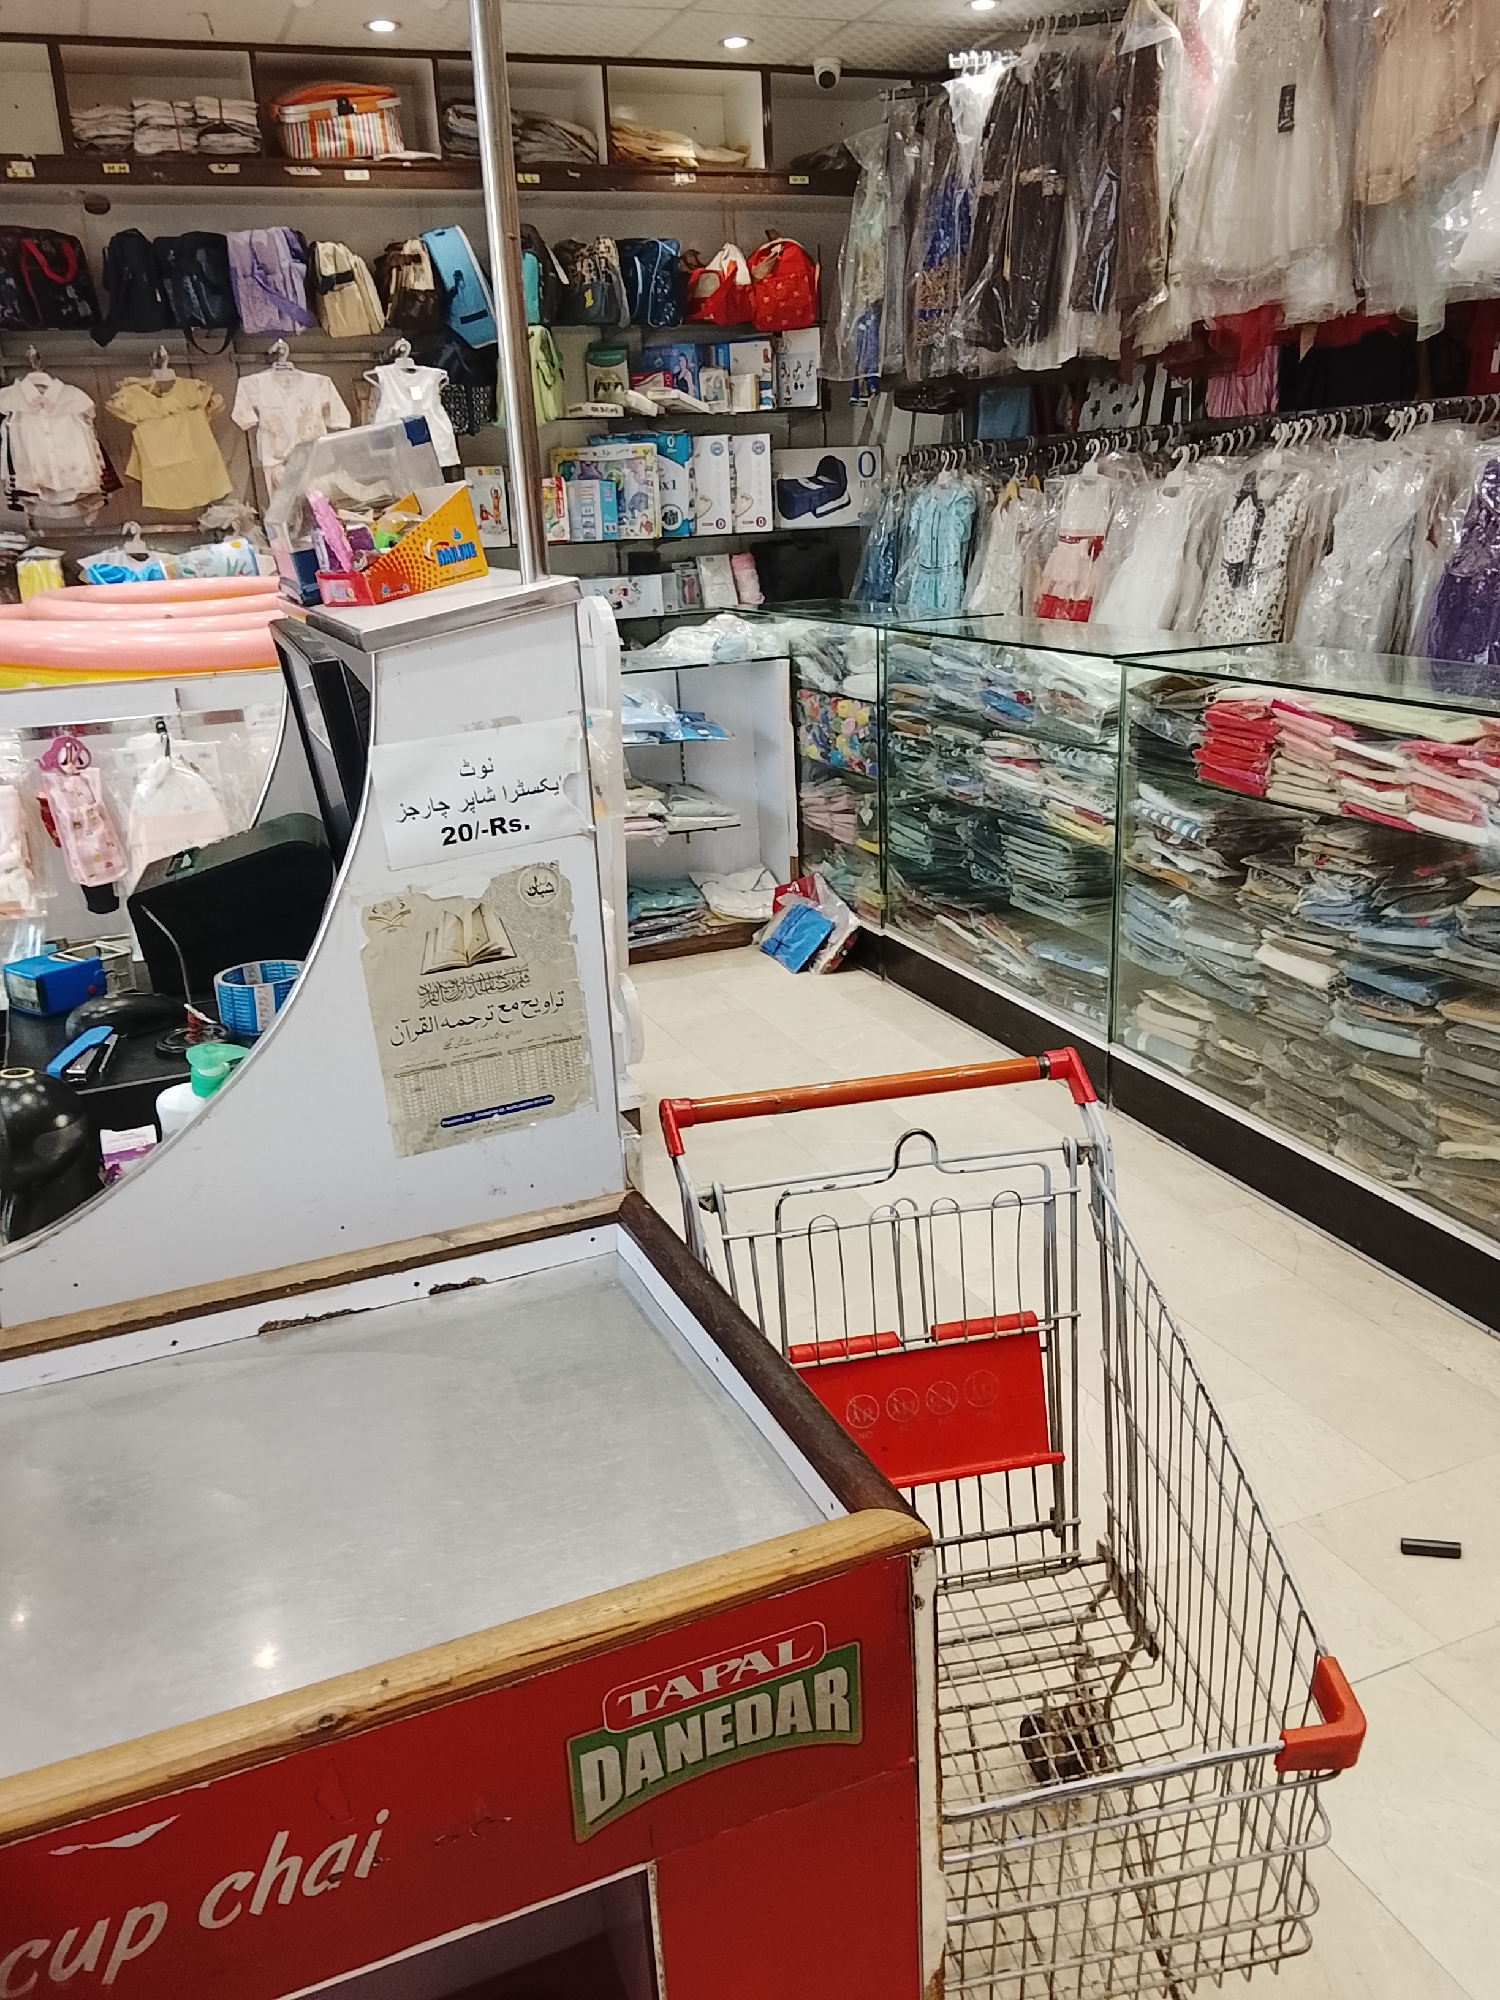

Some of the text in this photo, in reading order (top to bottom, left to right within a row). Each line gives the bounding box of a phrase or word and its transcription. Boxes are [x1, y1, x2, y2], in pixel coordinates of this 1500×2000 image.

[858, 450, 877, 478] 0
[459, 756, 495, 780] نوٹ
[395, 798, 451, 823] چارجز
[458, 786, 497, 814] شاپر
[441, 816, 530, 846] 20/-Rs.
[497, 1001, 520, 1024] مع
[858, 1430, 873, 1440] NO
[616, 1638, 814, 1720] TAPAL
[579, 1666, 852, 1825] DANEDAR
[0, 1808, 390, 2000] cup chai
